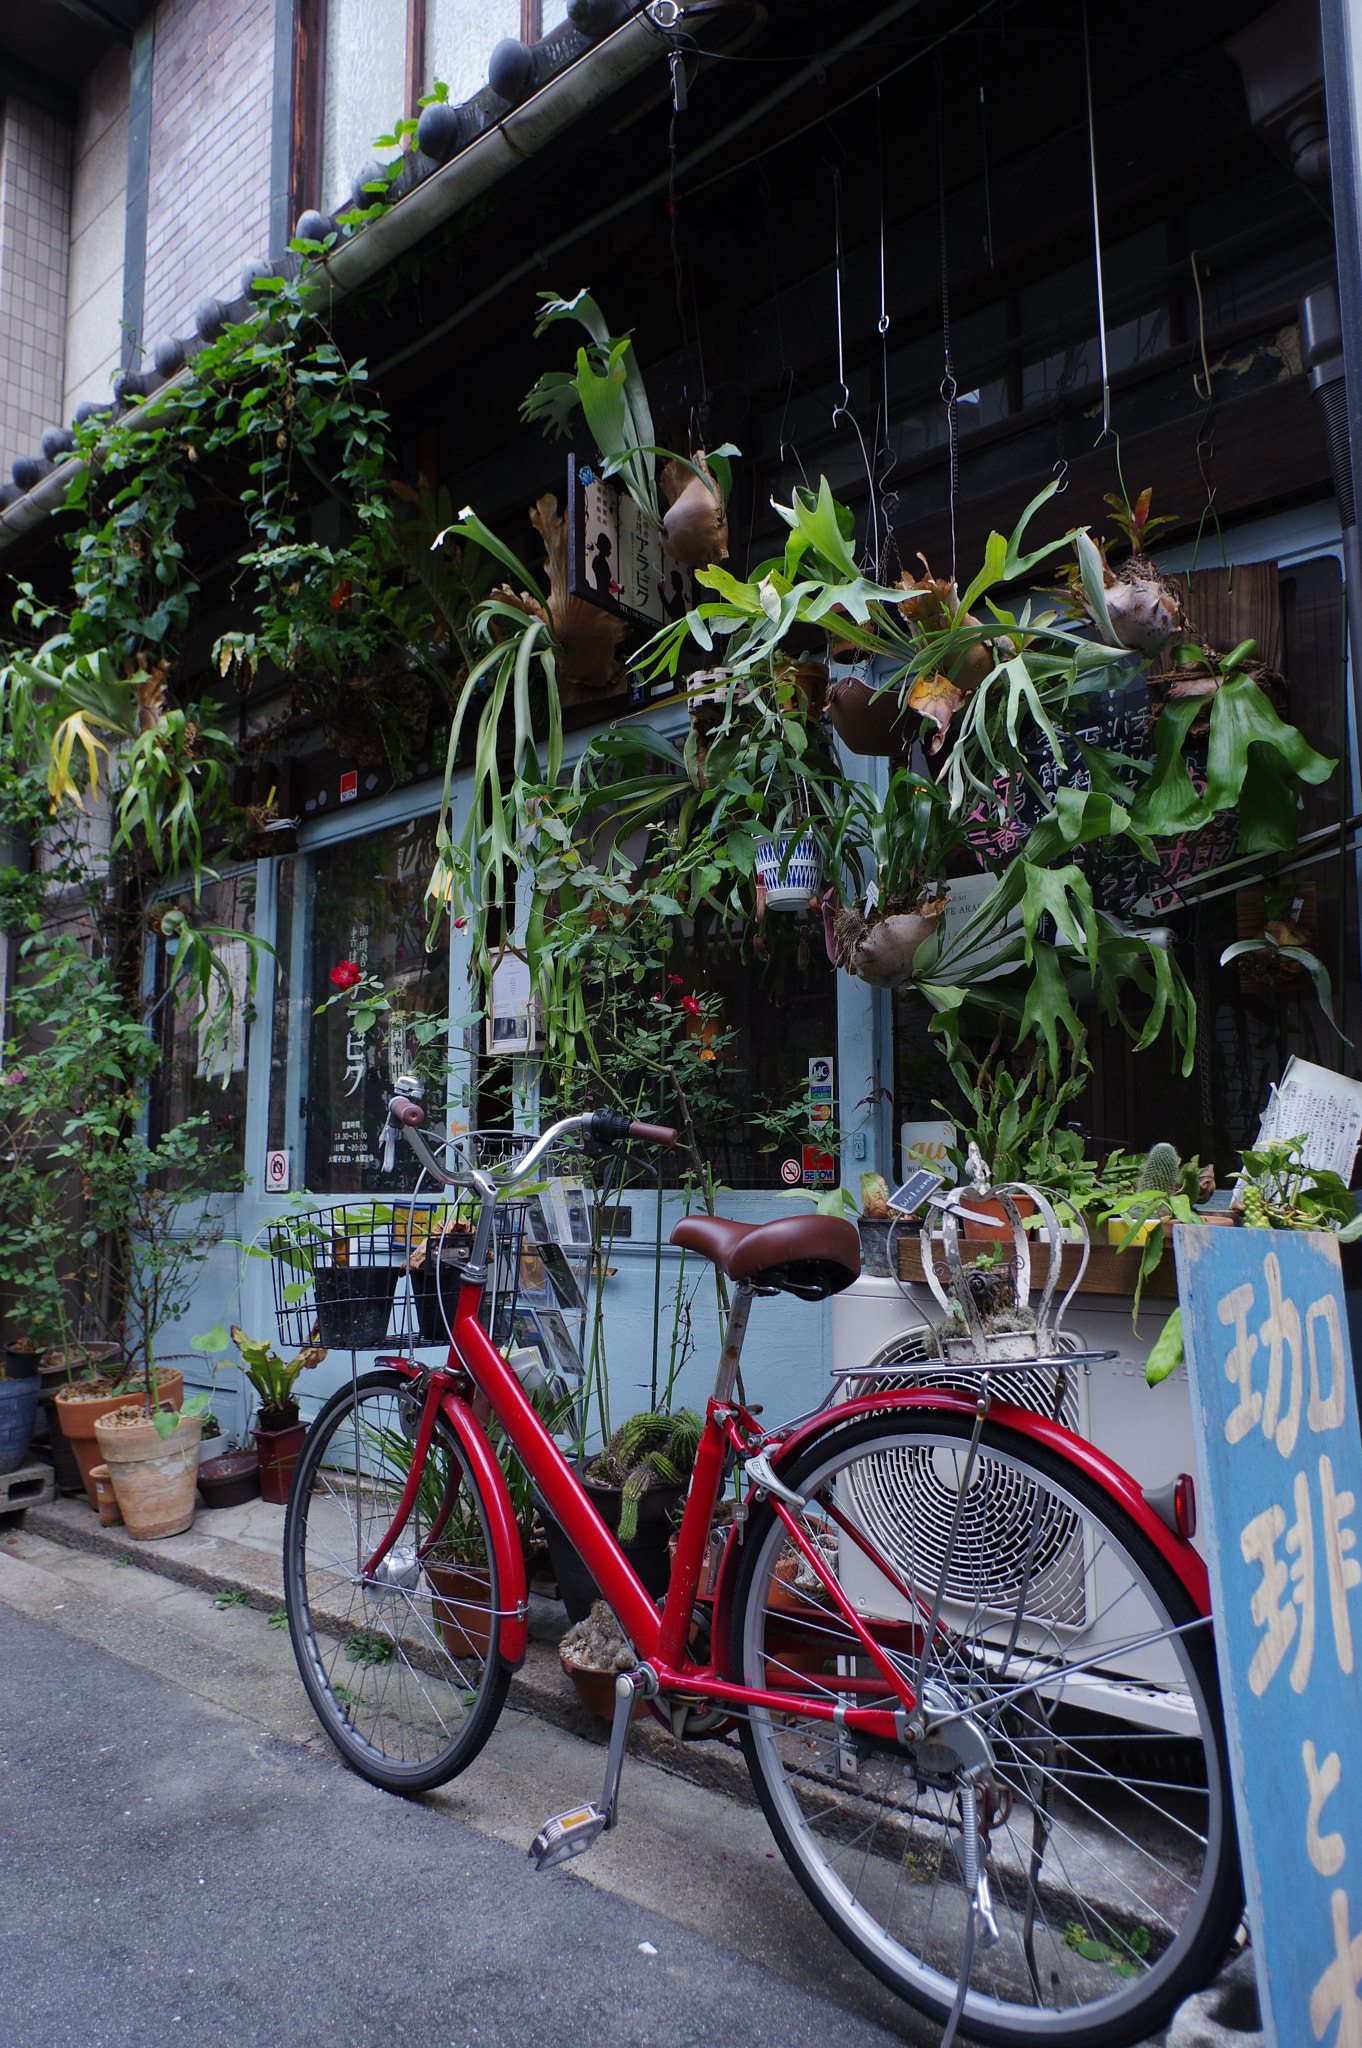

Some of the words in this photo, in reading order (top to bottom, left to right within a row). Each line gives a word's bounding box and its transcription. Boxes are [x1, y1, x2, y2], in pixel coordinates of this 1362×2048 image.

[636, 535, 649, 607] アラビク
[908, 1141, 947, 1161] au
[804, 1170, 833, 1180] SECOM
